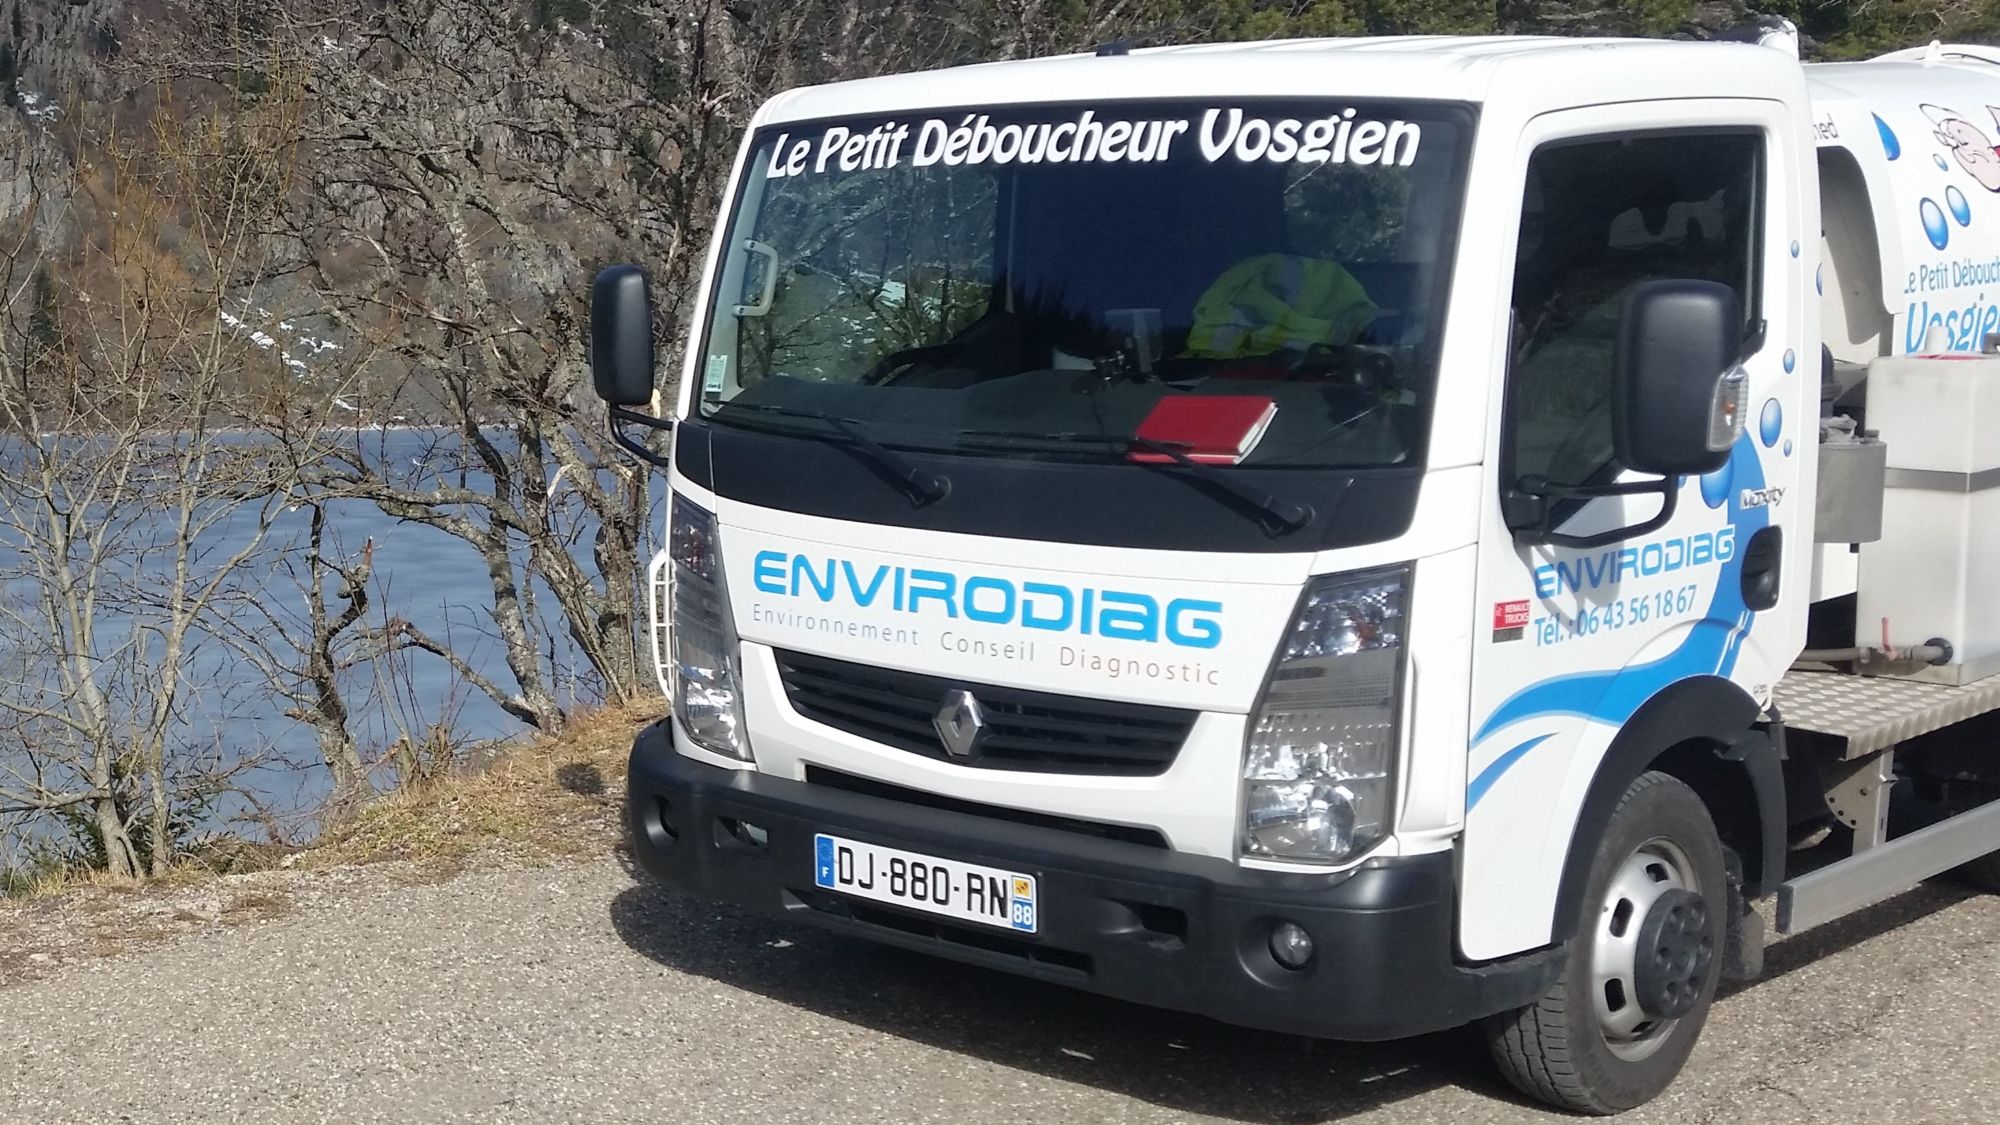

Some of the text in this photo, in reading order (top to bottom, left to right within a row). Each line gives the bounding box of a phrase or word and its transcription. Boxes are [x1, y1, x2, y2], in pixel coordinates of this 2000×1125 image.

[766, 107, 1422, 179] Le Petit Déboucheur Vosgien
[1919, 262, 1949, 292] Petit
[1576, 607, 1600, 637] 06
[1603, 600, 1625, 631] 43
[1628, 594, 1650, 626] 56
[1654, 589, 1674, 619] 18
[1676, 584, 1698, 614] 67
[753, 603, 1219, 686] Environnement Conseil Diagnostic
[822, 868, 829, 878] F
[1012, 903, 1032, 926] 88
